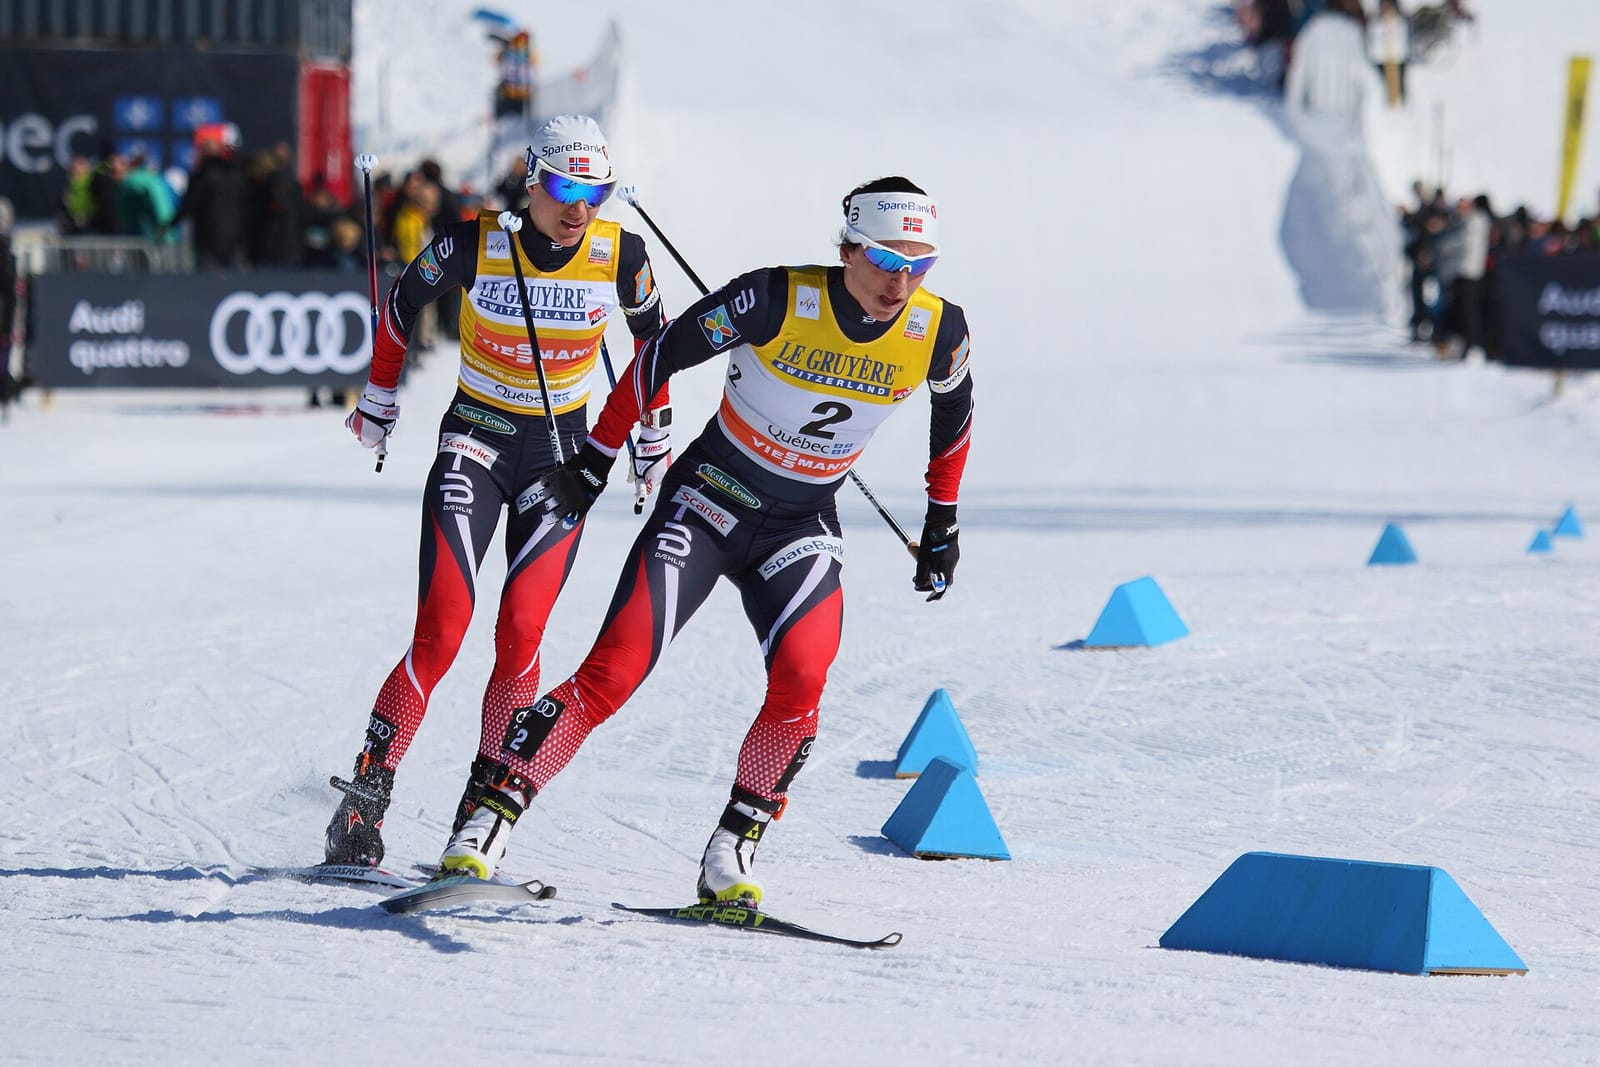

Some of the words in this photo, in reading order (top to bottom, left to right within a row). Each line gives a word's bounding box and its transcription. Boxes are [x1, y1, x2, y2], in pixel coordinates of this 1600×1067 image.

[0, 113, 97, 174] ec
[479, 282, 500, 300] LE
[69, 301, 145, 334] Audi
[481, 301, 581, 320] SWITZRLAND
[69, 338, 190, 375] quattro
[777, 341, 805, 365] LE
[728, 364, 742, 388] 2
[776, 363, 888, 396] SWITZERLAND
[495, 385, 544, 403] Québe
[799, 401, 853, 440] 2
[442, 438, 491, 462] Scandic
[768, 424, 830, 454] Québec
[681, 491, 729, 529] Scandic
[510, 728, 528, 751] 2
